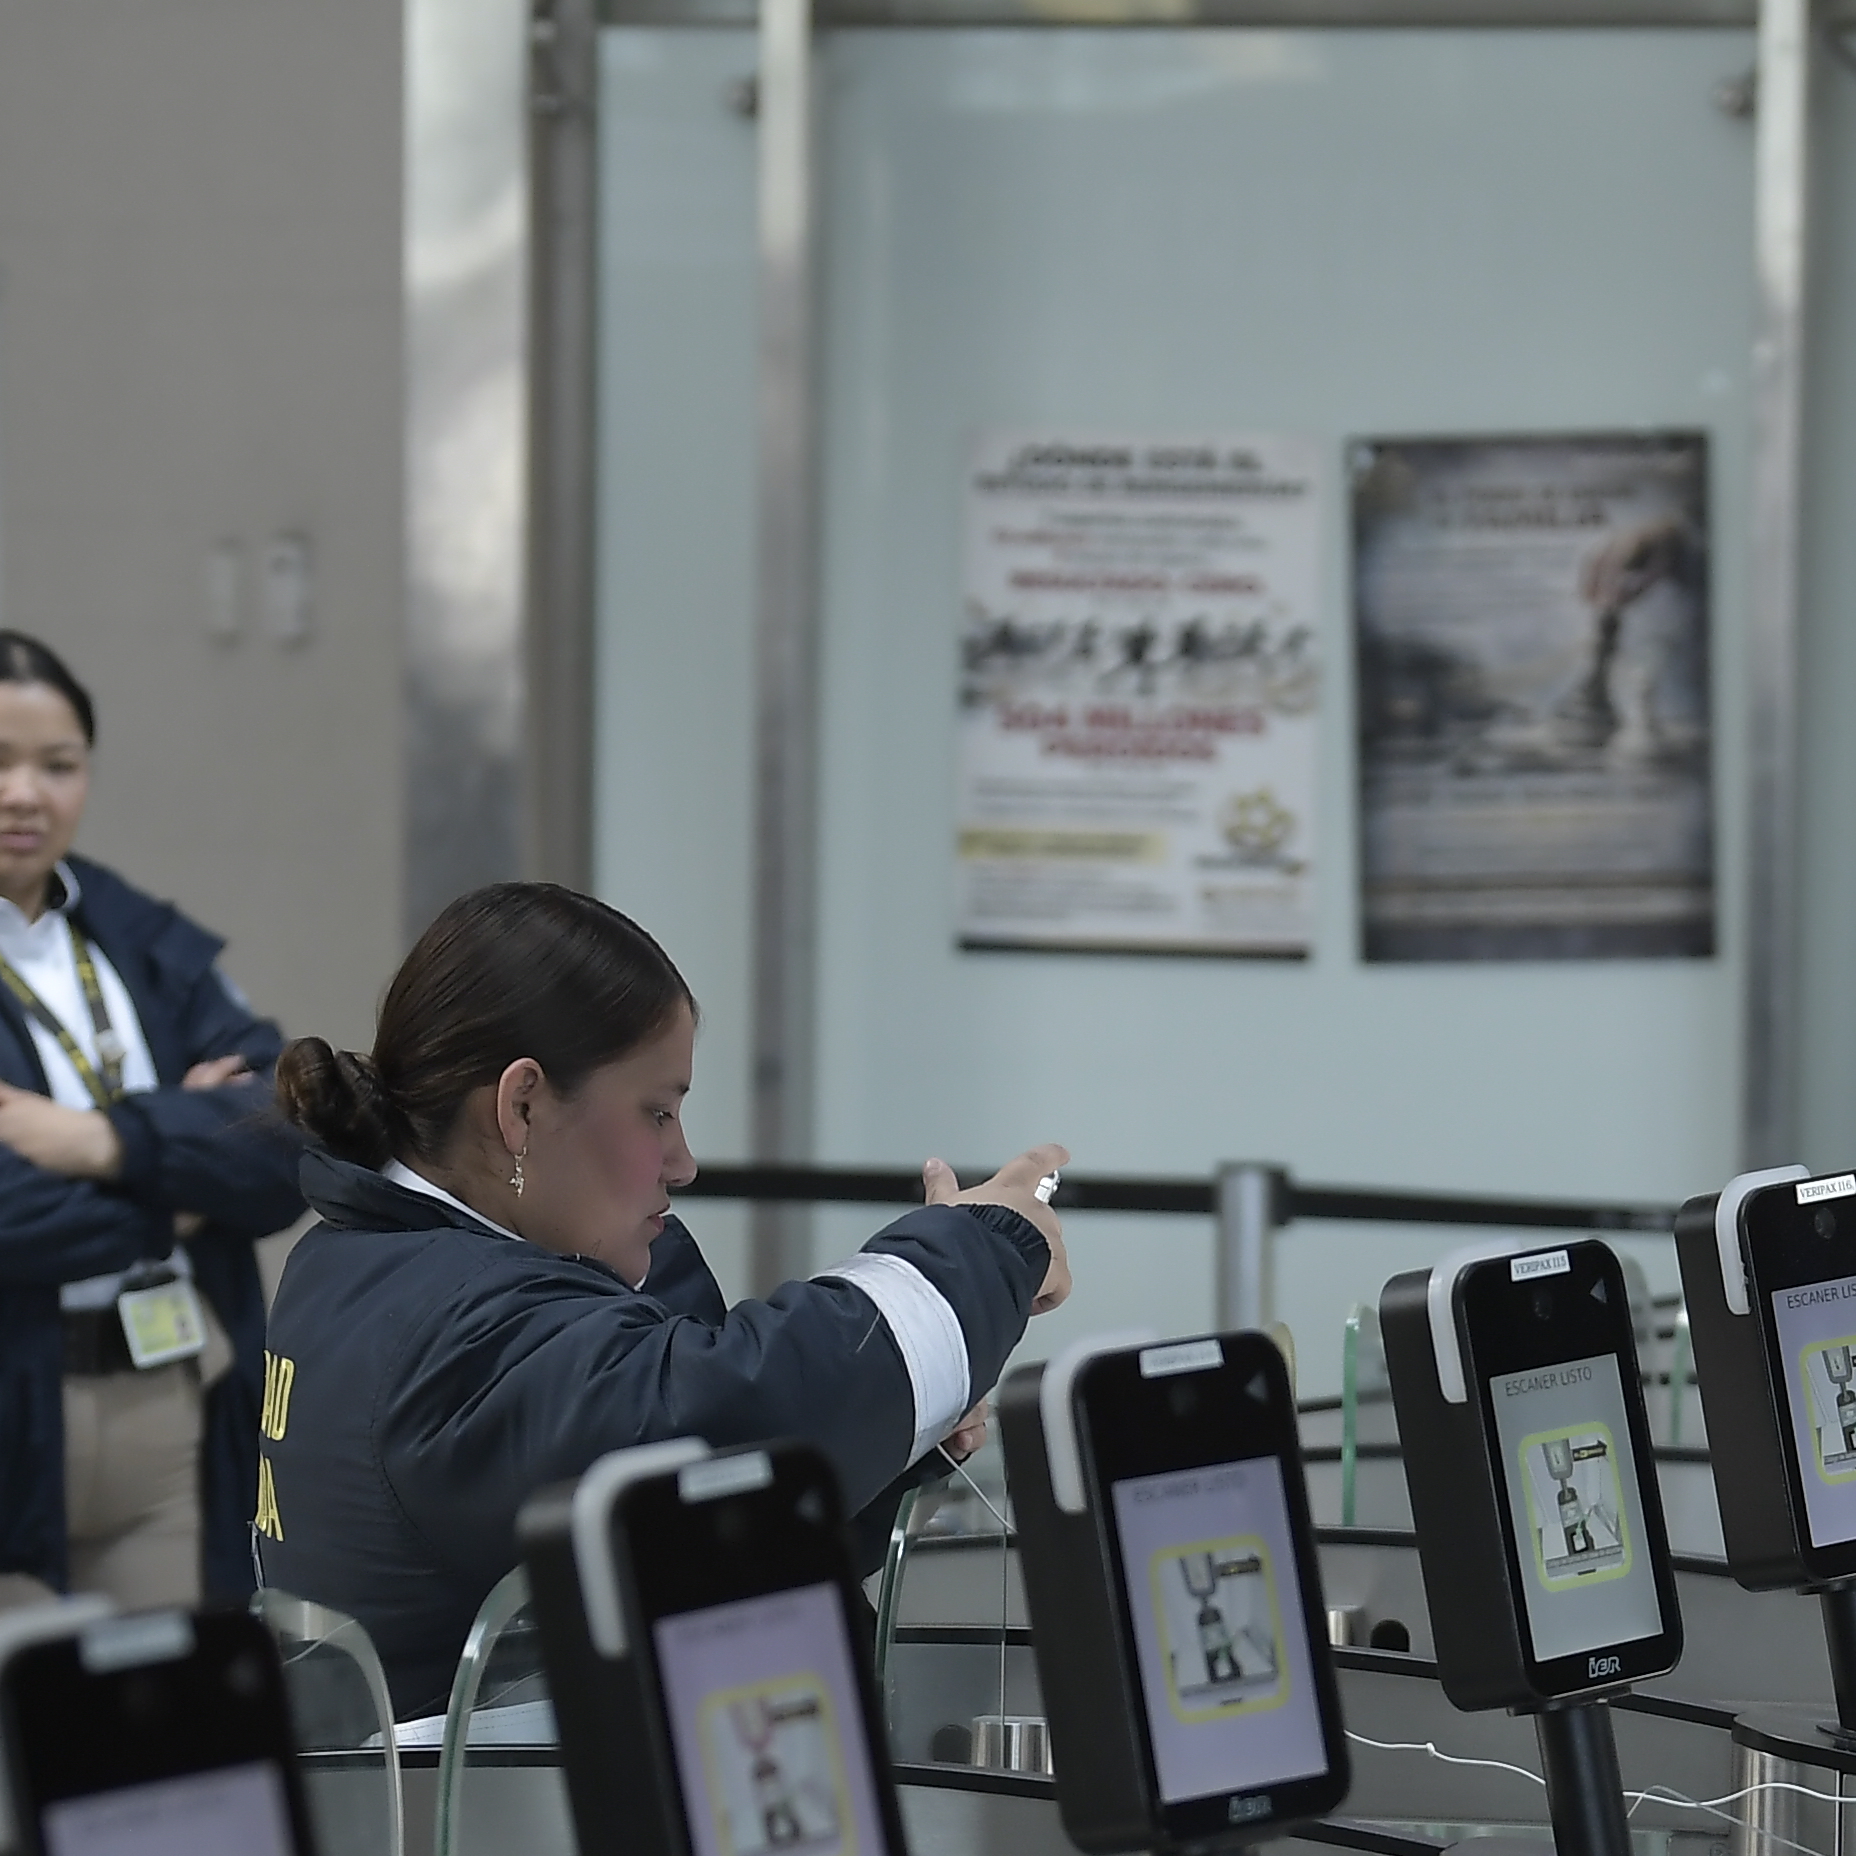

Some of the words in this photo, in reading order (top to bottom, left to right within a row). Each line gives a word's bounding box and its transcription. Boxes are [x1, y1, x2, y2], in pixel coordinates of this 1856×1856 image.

[1799, 1182, 1837, 1198] VERIPAX
[1786, 1287, 1840, 1310] ESCANER
[1505, 1372, 1558, 1397] ESCANER
[1560, 1366, 1593, 1387] LISTO
